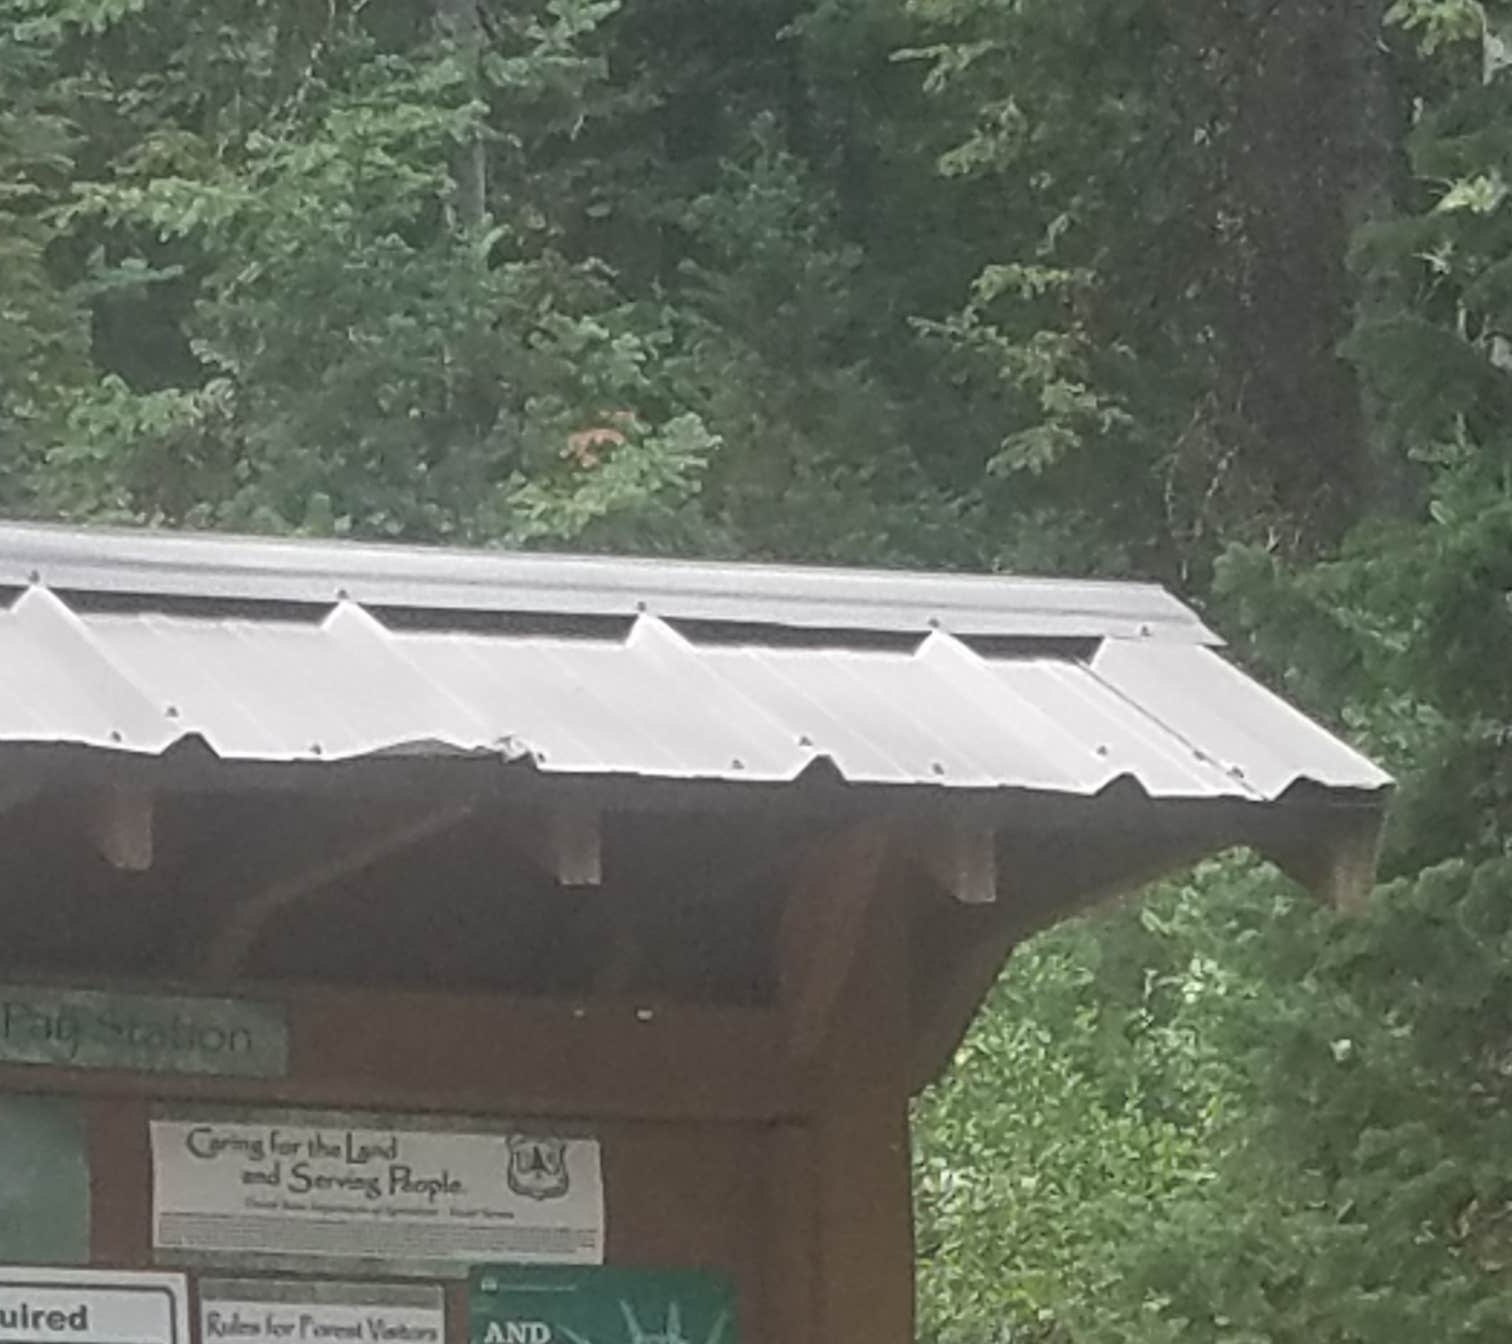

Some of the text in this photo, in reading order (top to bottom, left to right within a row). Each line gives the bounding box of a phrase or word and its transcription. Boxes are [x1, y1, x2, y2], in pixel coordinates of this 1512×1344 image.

[187, 1128, 399, 1165] Caring for the Land
[289, 1163, 381, 1198] Serving
[206, 1311, 262, 1339] Rules
[265, 1311, 295, 1339] for
[484, 1321, 552, 1344] AND
